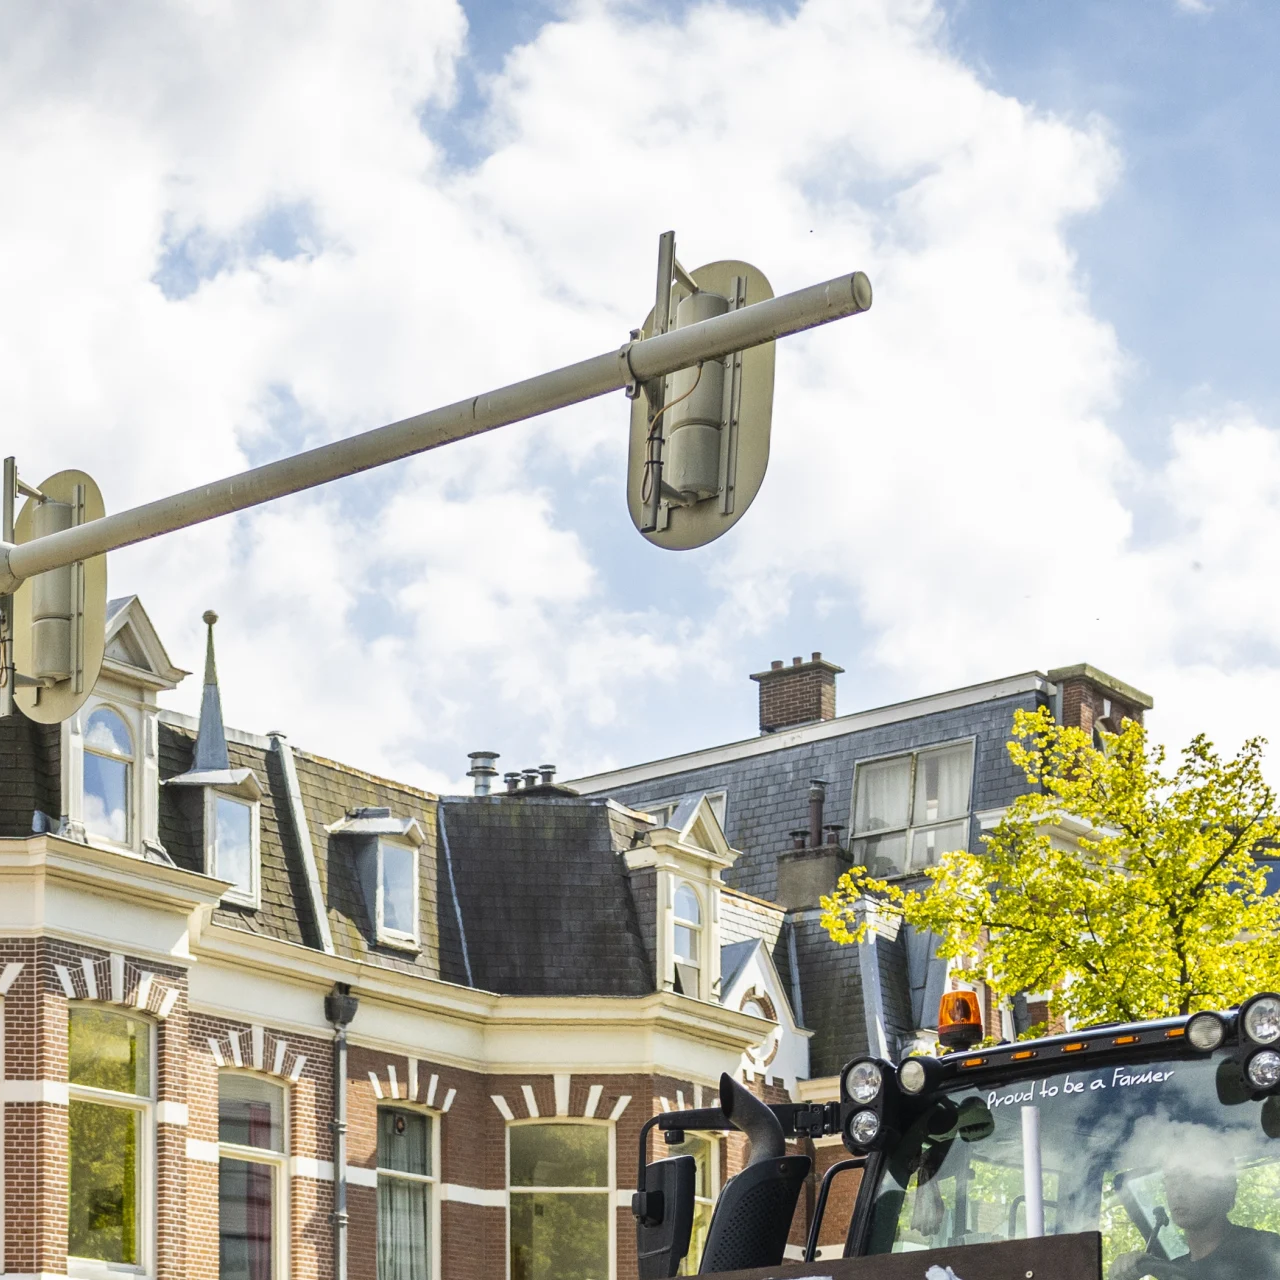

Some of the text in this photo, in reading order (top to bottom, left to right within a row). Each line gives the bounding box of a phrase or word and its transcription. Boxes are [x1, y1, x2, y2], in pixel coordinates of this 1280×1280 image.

[987, 1066, 1175, 1110] Proud to be a Farmer
